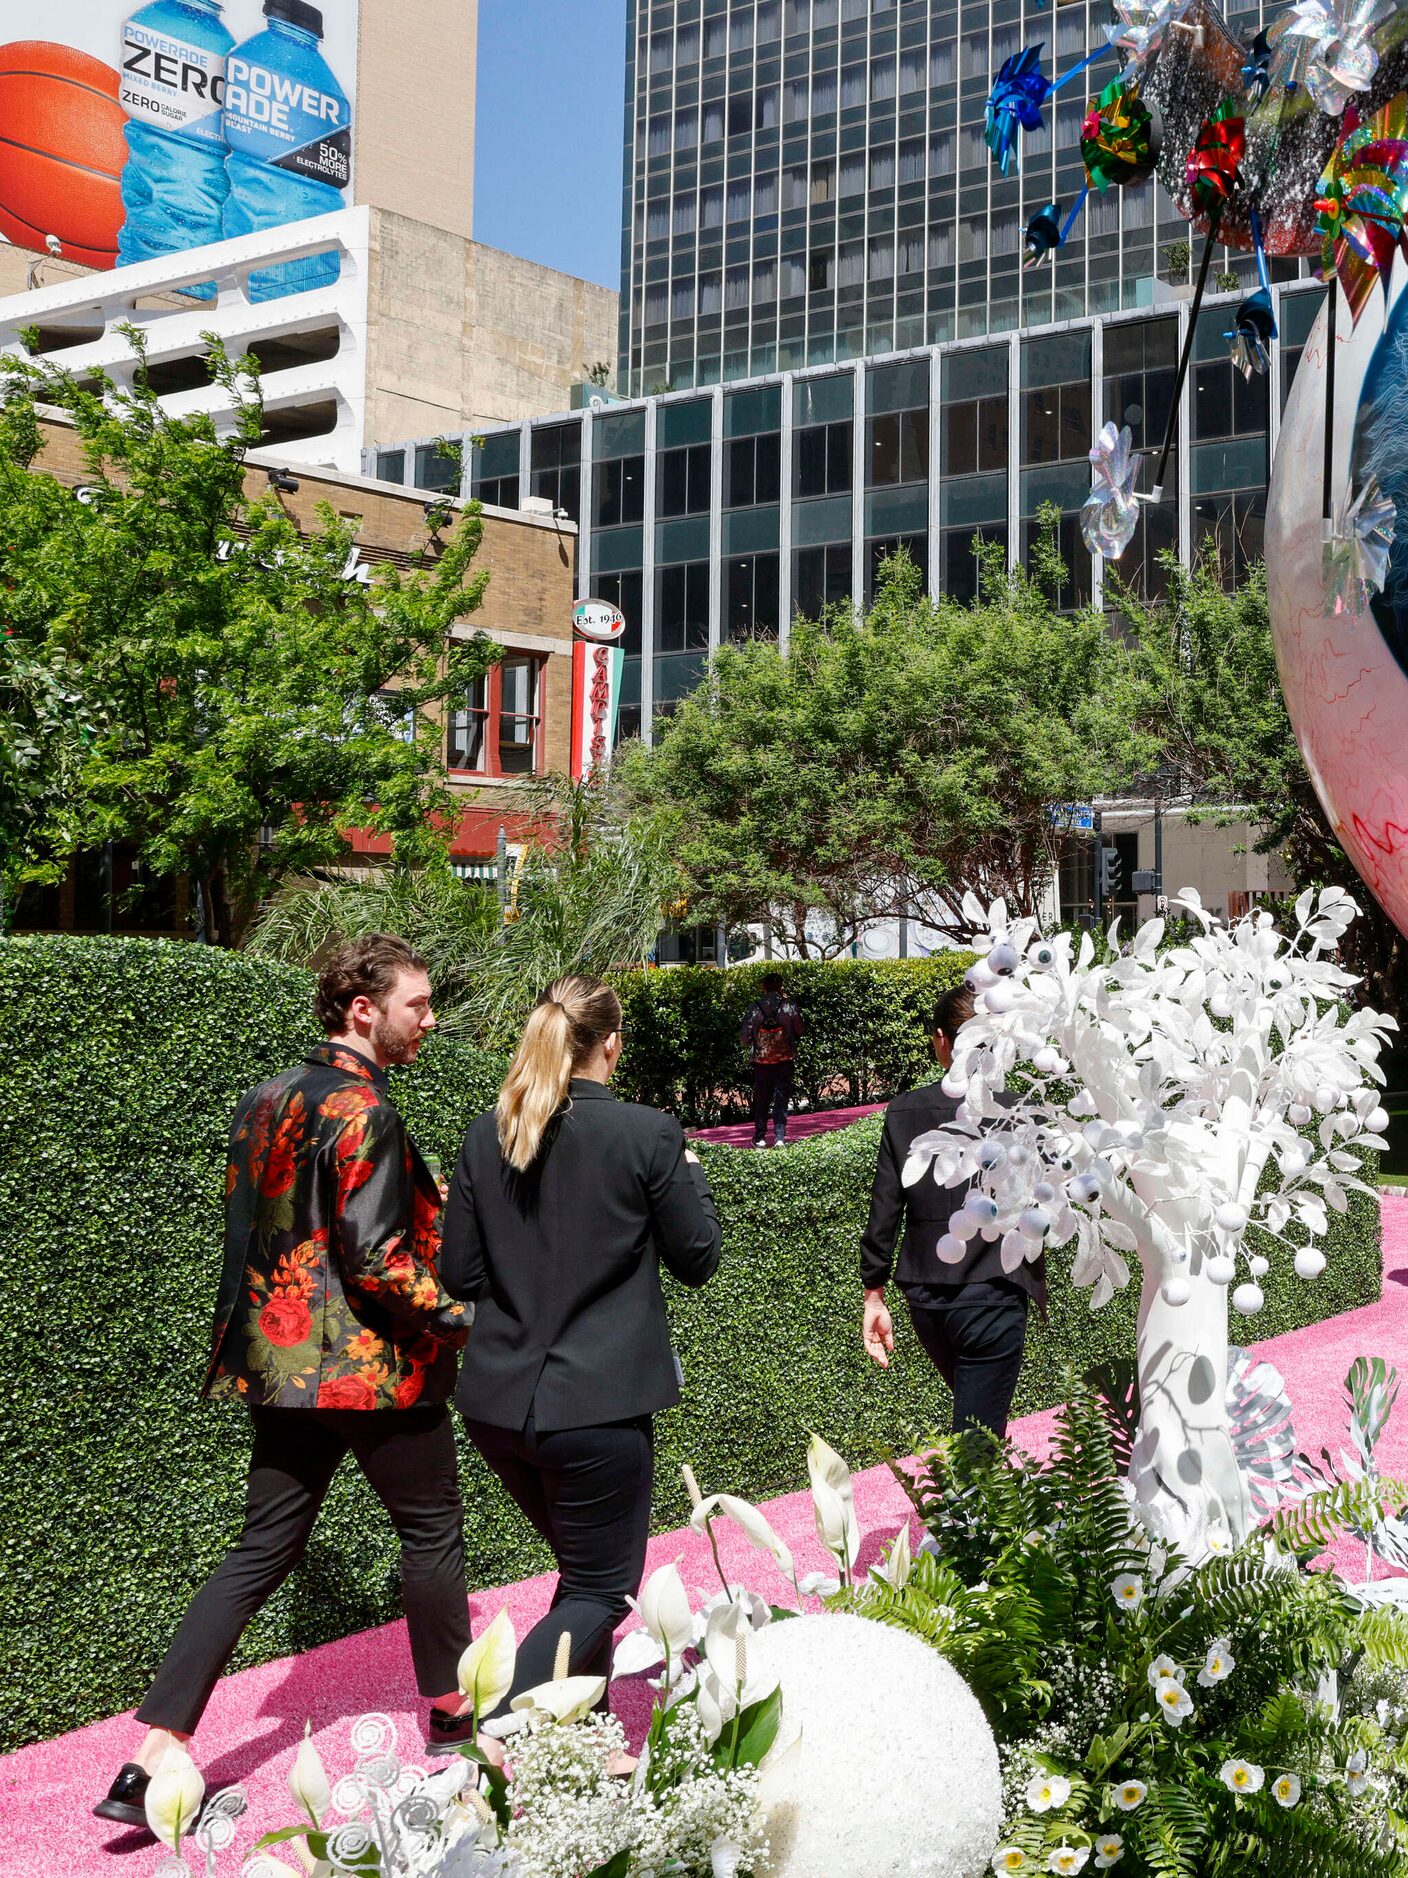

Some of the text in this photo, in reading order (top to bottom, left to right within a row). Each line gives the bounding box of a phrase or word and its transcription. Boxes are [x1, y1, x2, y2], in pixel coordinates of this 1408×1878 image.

[124, 26, 208, 68] POWERADE
[123, 71, 178, 97] MIXED BERRY
[227, 56, 340, 125] POWER
[123, 89, 160, 113] ZERO
[161, 103, 187, 118] CALORIE
[225, 84, 290, 131] ADE
[161, 109, 183, 122] SUGAR
[225, 118, 252, 134] BLAST
[225, 111, 295, 143] MOUNTAIN BERRY
[319, 142, 348, 165] 50%
[319, 156, 348, 174] MORE
[296, 156, 347, 181] ELECTROLYTES
[576, 615, 595, 625] Est.
